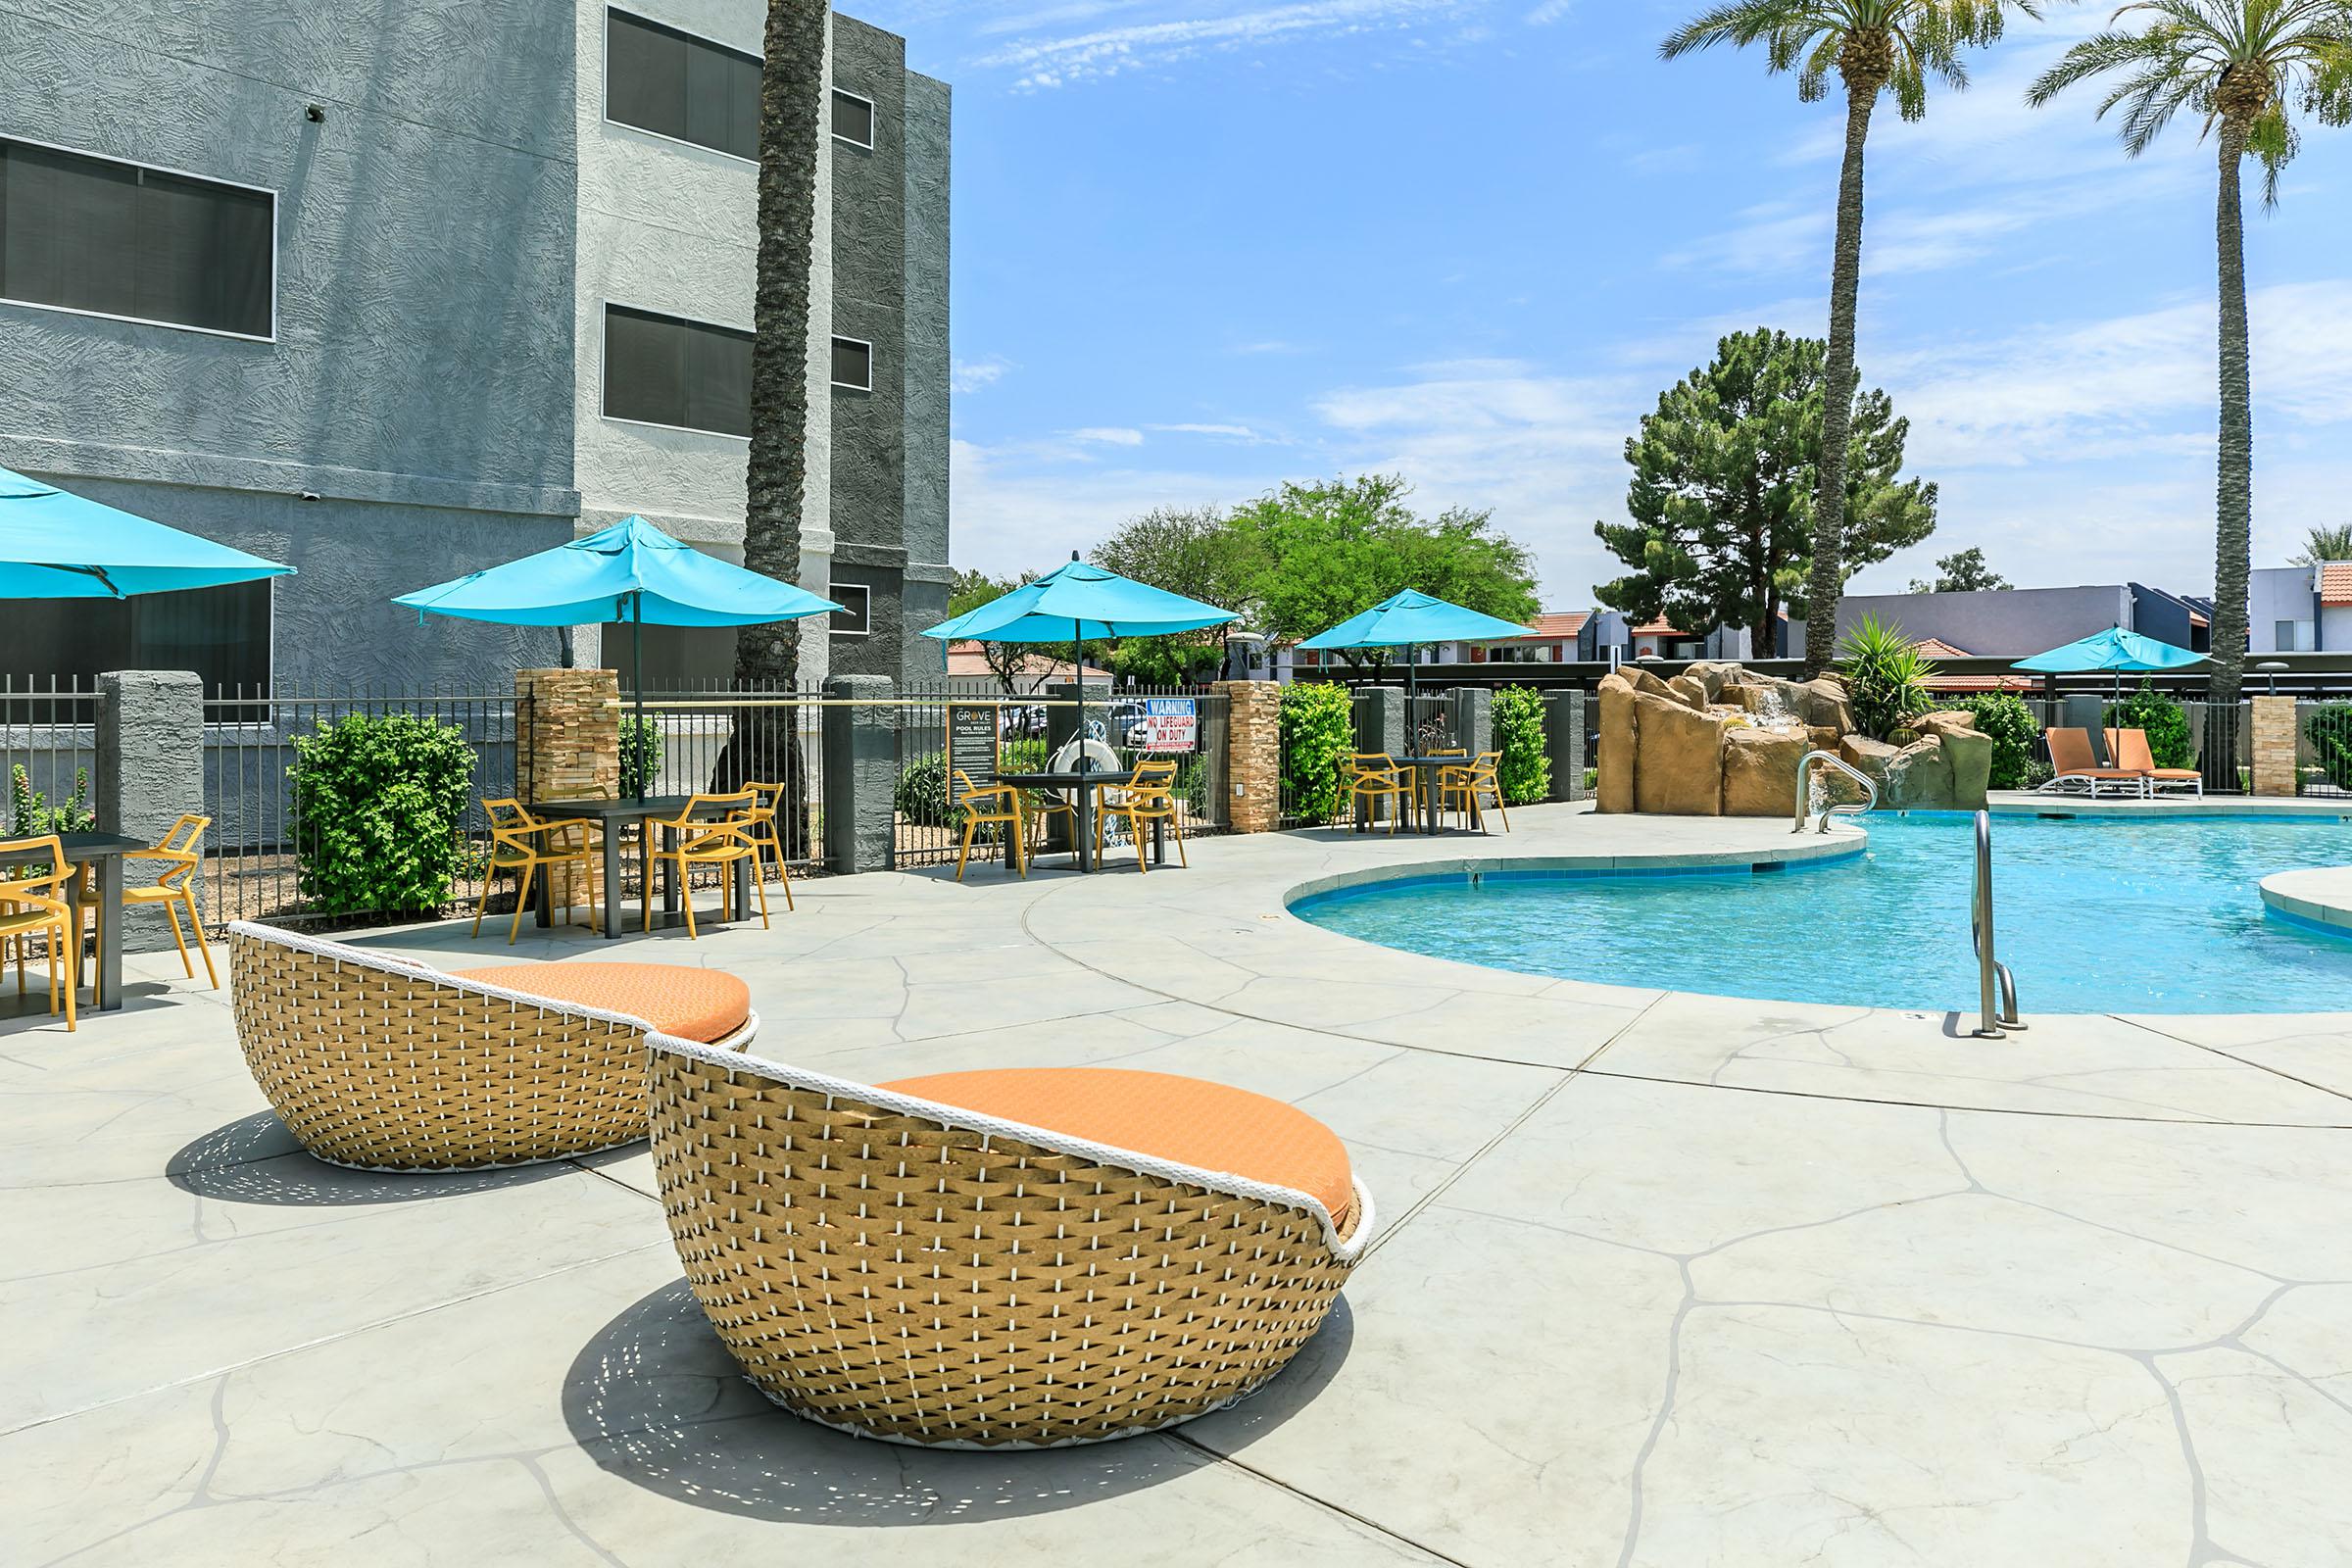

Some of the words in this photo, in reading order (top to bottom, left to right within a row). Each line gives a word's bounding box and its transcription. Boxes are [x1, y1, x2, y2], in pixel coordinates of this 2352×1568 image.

[1150, 700, 1192, 715] WARNING
[956, 710, 991, 721] GROVE
[1148, 716, 1157, 728] NO
[1160, 716, 1195, 727] LIFEGUARD
[1157, 729, 1167, 741] ON
[1169, 729, 1186, 741] DUTY
